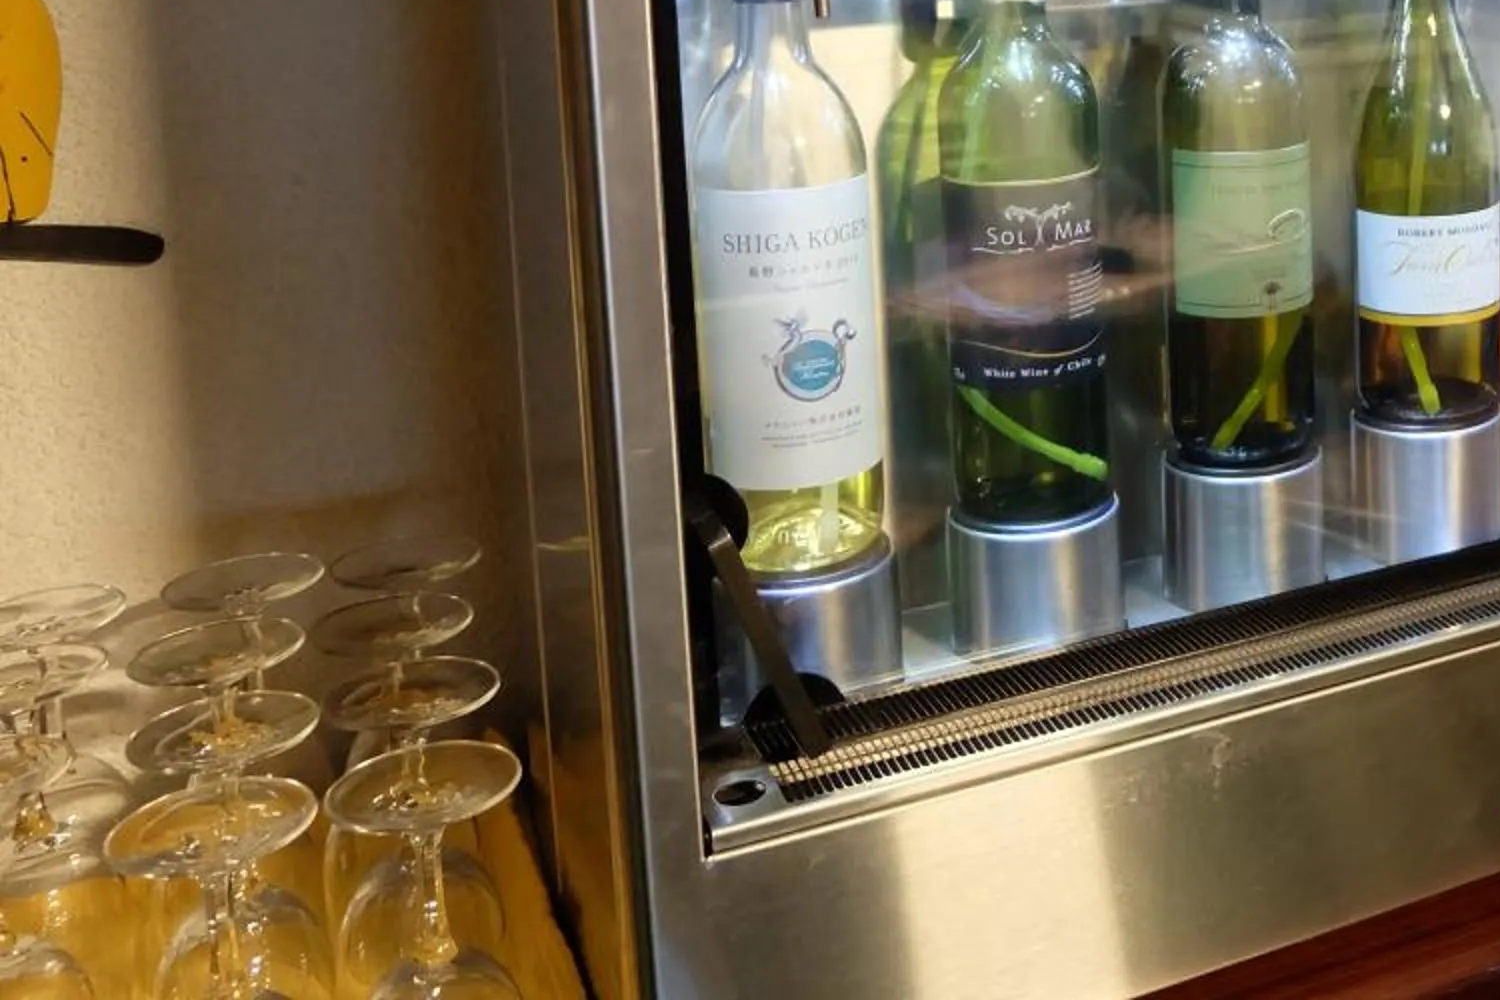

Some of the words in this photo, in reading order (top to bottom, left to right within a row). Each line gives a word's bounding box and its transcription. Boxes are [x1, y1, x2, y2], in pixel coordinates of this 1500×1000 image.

[986, 227, 1026, 245] SOL
[1055, 219, 1092, 241] MAR
[722, 233, 800, 255] SHIGA
[984, 367, 1016, 379] White
[1020, 367, 1049, 377] Wine
